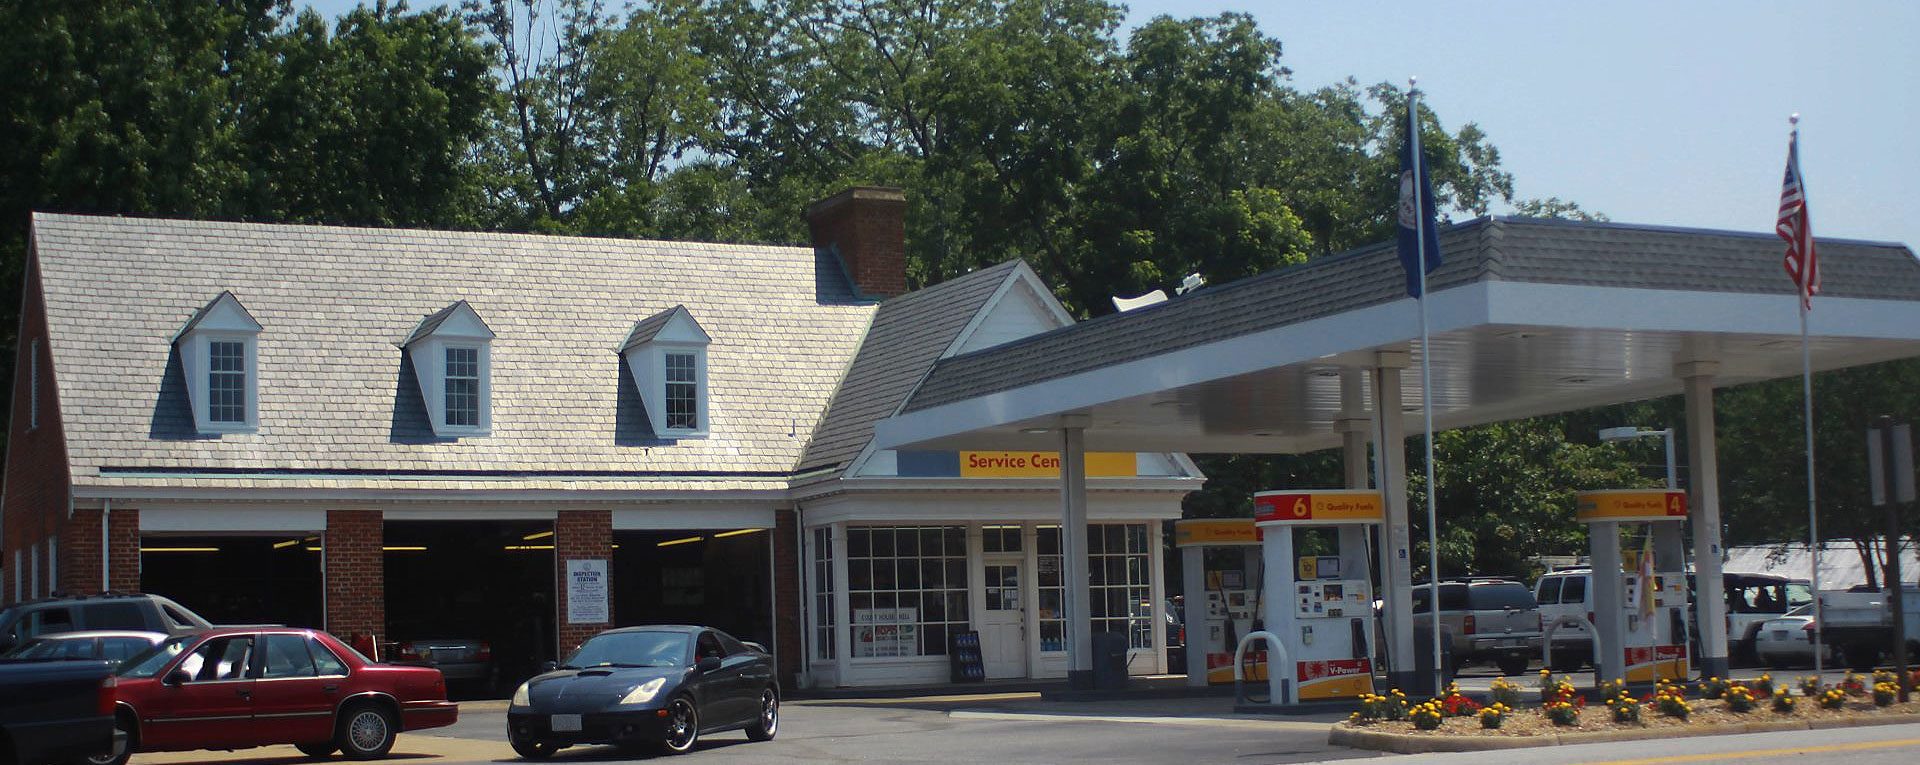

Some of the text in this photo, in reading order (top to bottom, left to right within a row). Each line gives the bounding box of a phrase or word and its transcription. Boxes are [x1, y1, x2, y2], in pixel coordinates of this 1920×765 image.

[969, 453, 1060, 468] Service Cen
[1293, 498, 1307, 517] 6
[1327, 502, 1374, 512] Quality Fuels
[1670, 496, 1681, 512] 4
[1330, 666, 1361, 675] V-Power
